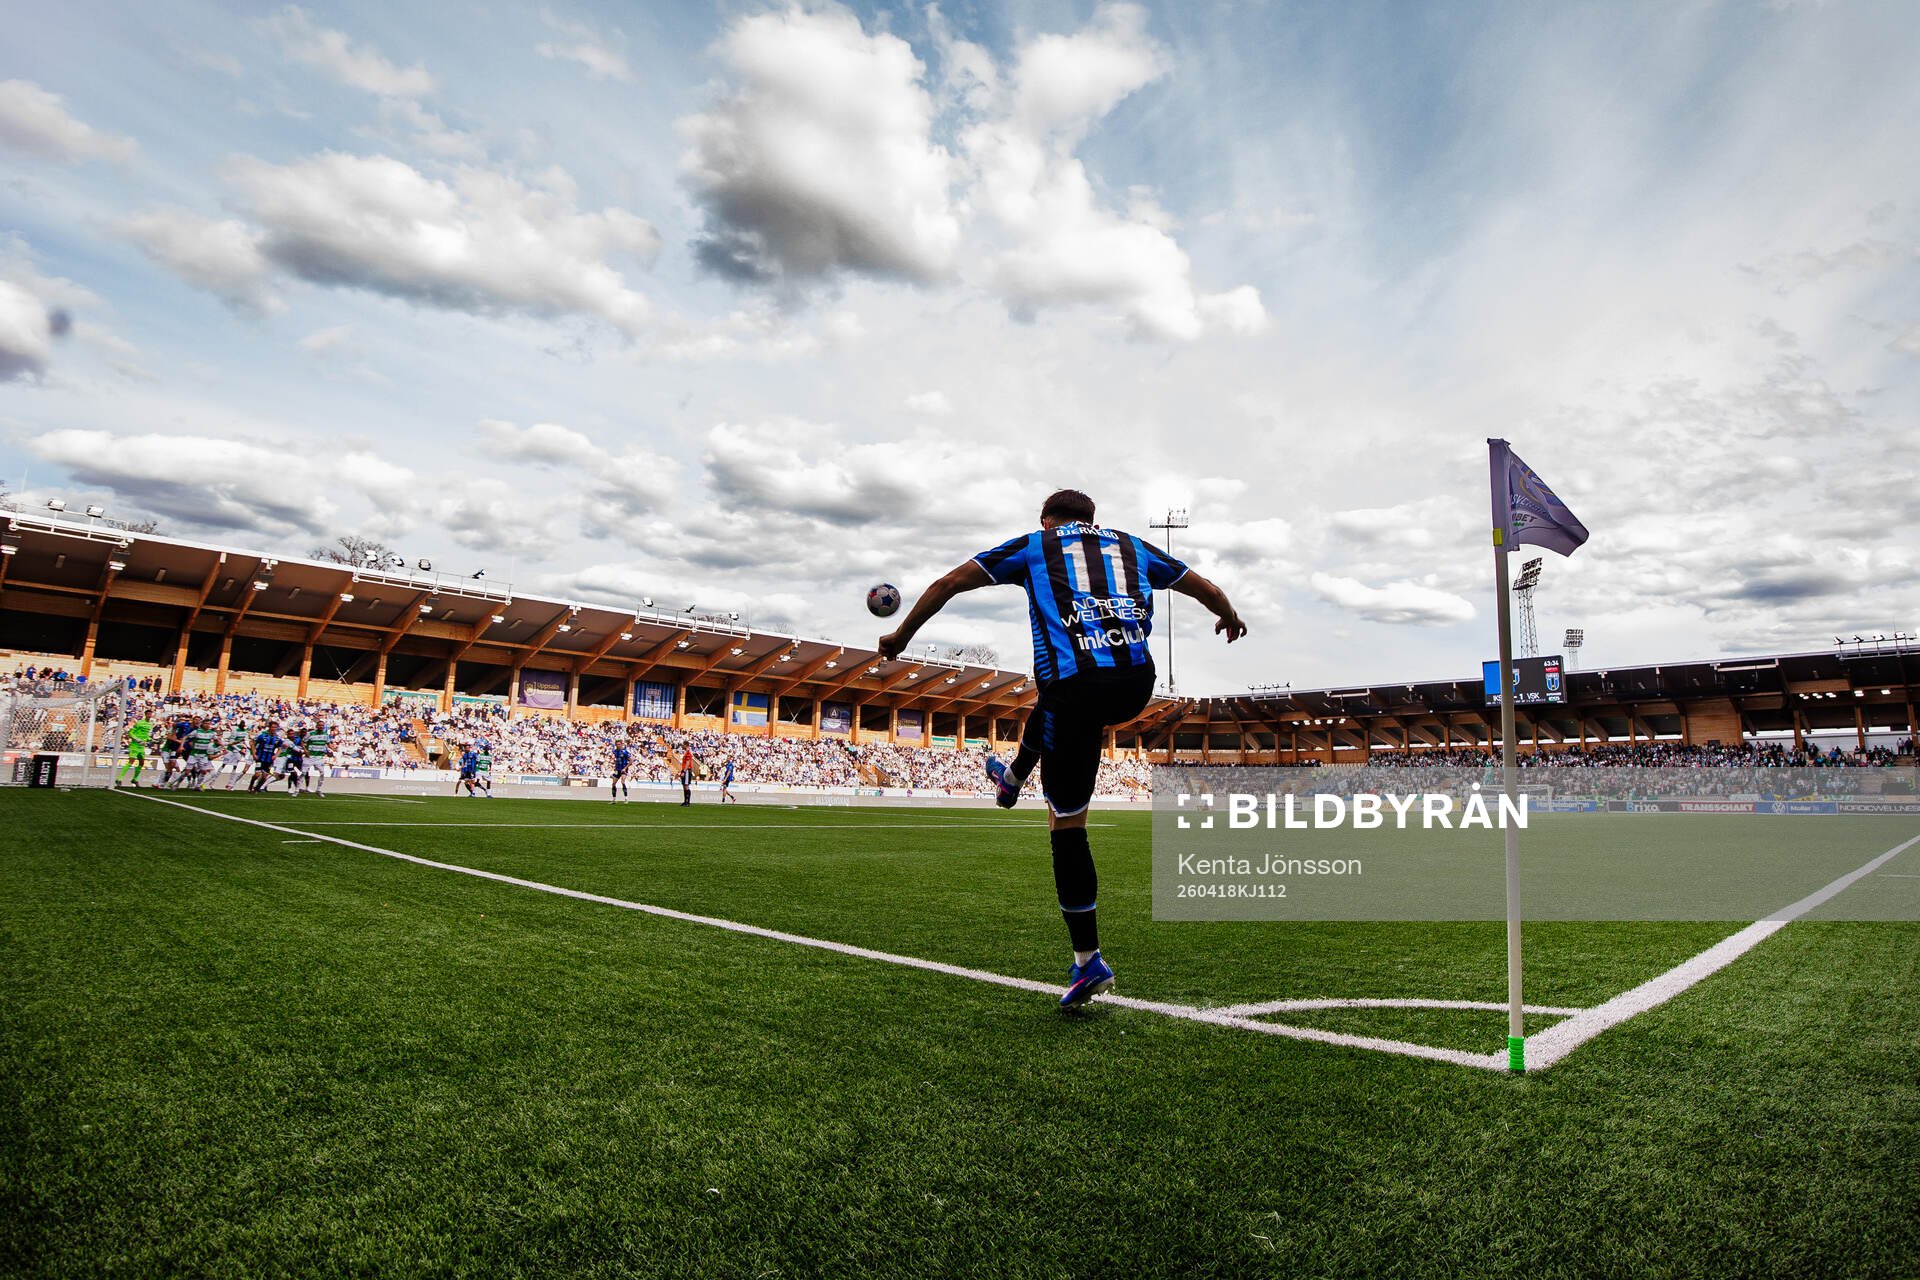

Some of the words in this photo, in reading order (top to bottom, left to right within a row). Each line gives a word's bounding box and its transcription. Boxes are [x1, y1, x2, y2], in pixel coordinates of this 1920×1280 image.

[1056, 526, 1120, 540] BJERKEBO
[1062, 541, 1129, 597] 11
[1072, 596, 1137, 611] NORDIC
[1061, 607, 1148, 628] WELLNESS
[1526, 692, 1540, 700] VSK
[1681, 804, 1754, 812] TRANSSCHAKT
